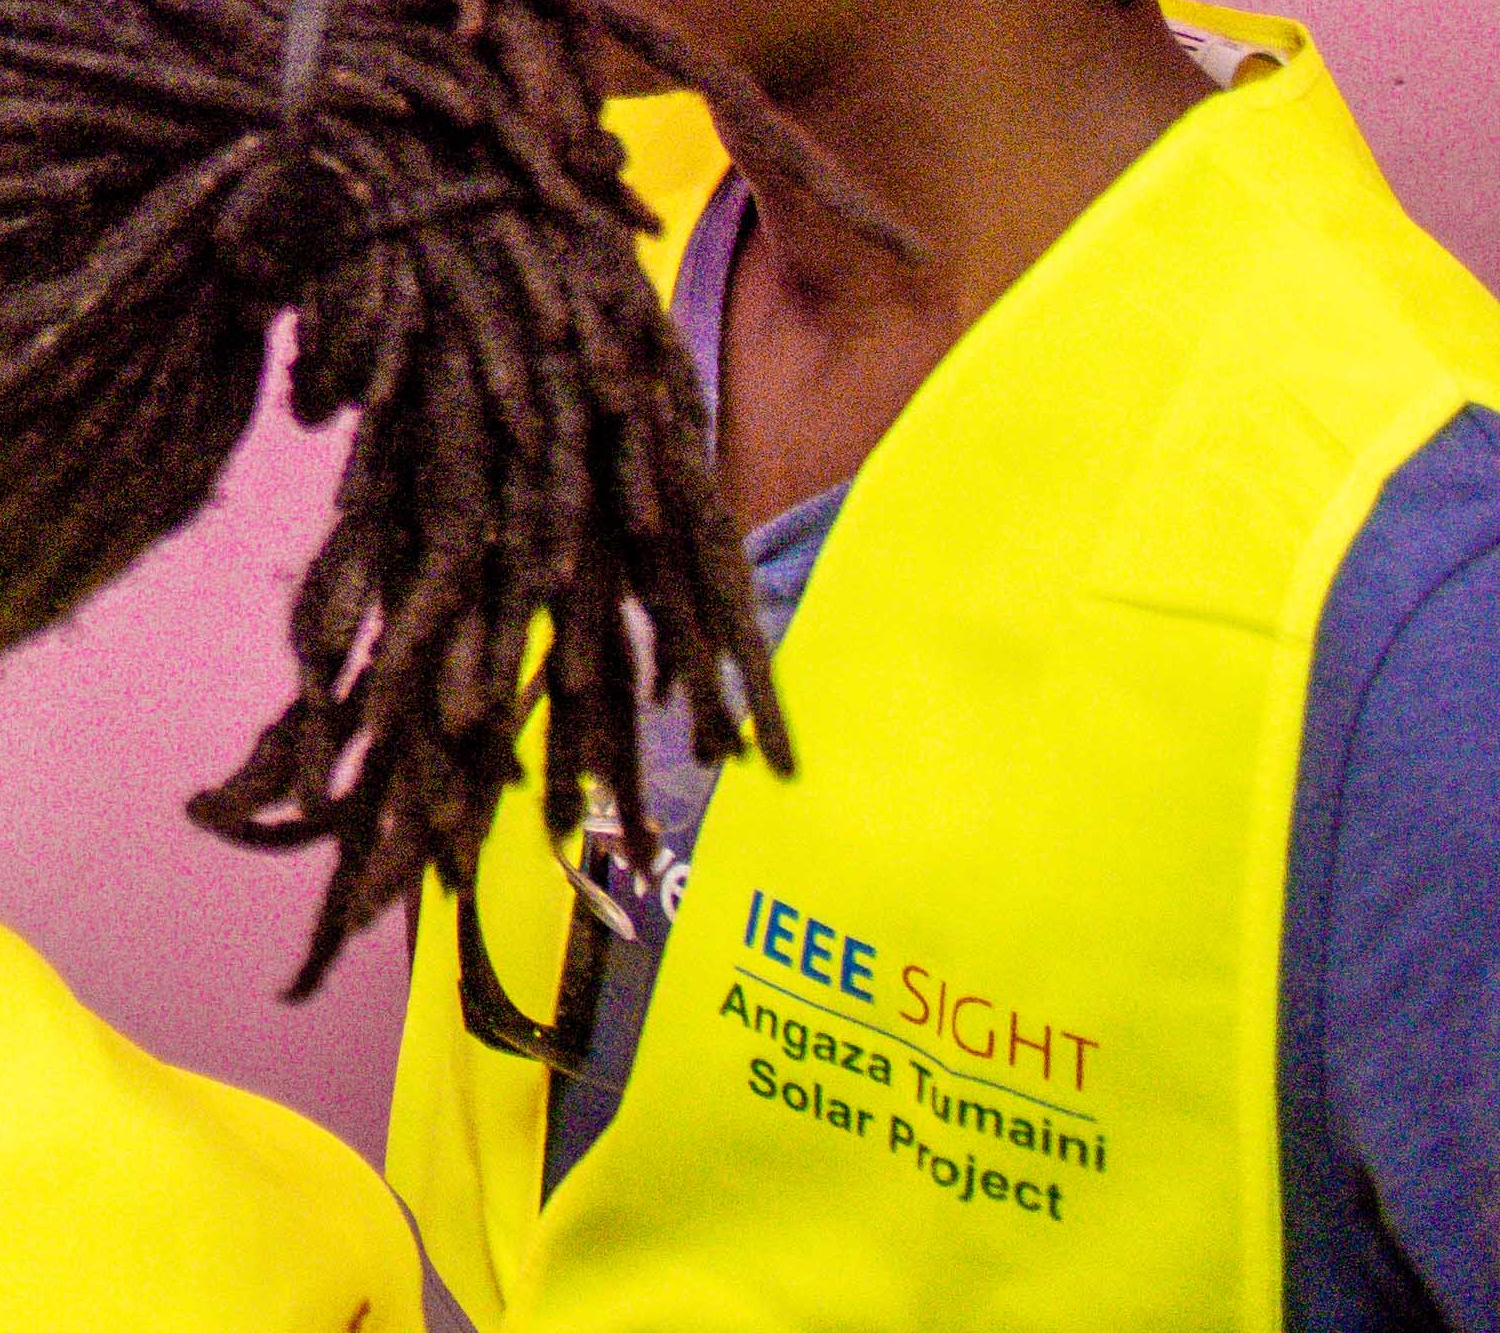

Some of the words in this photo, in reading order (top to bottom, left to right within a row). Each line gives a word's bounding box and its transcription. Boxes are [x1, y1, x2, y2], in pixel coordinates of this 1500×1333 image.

[719, 981, 893, 1086] Angaza
[908, 1056, 1108, 1173] Tumaini
[743, 889, 877, 1004] IEEE
[900, 965, 1100, 1091] SIGHT
[748, 1056, 875, 1138] Solar
[888, 1114, 1063, 1221] Project
